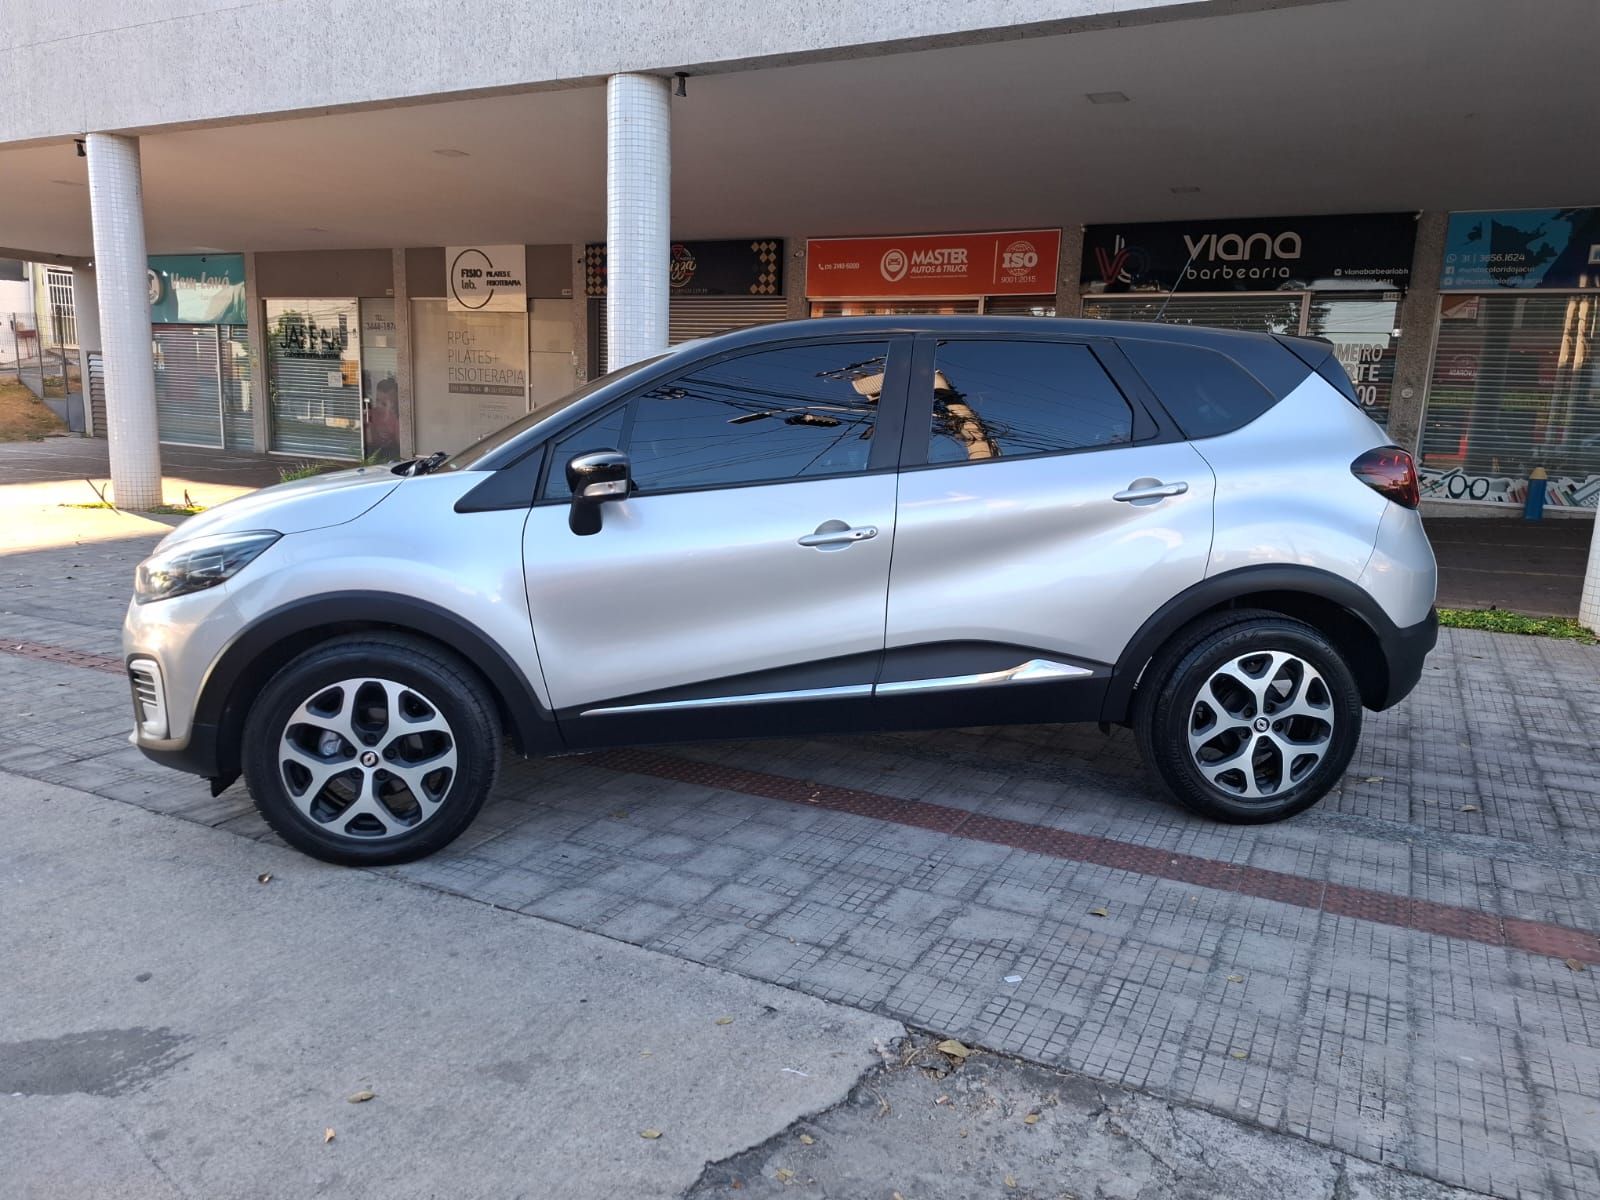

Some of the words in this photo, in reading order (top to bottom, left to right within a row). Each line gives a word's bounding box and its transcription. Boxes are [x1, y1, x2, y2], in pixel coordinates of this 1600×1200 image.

[910, 248, 968, 265] MASTER
[1002, 252, 1038, 268] ISO
[461, 268, 482, 278] FISIO
[486, 270, 506, 278] PILATES
[669, 258, 697, 281] izza
[910, 265, 936, 273] AUTOS
[936, 265, 942, 273] &
[943, 264, 968, 273] TRUCK
[1187, 265, 1290, 280] barbearia
[461, 280, 476, 290] lab.
[447, 330, 477, 346] RPG+
[447, 348, 500, 365] PILATES+
[1333, 344, 1383, 362] IMEIRO
[448, 367, 525, 385] FISIOTERAPIA
[1344, 363, 1380, 381] RTE
[1357, 385, 1377, 405] 00
